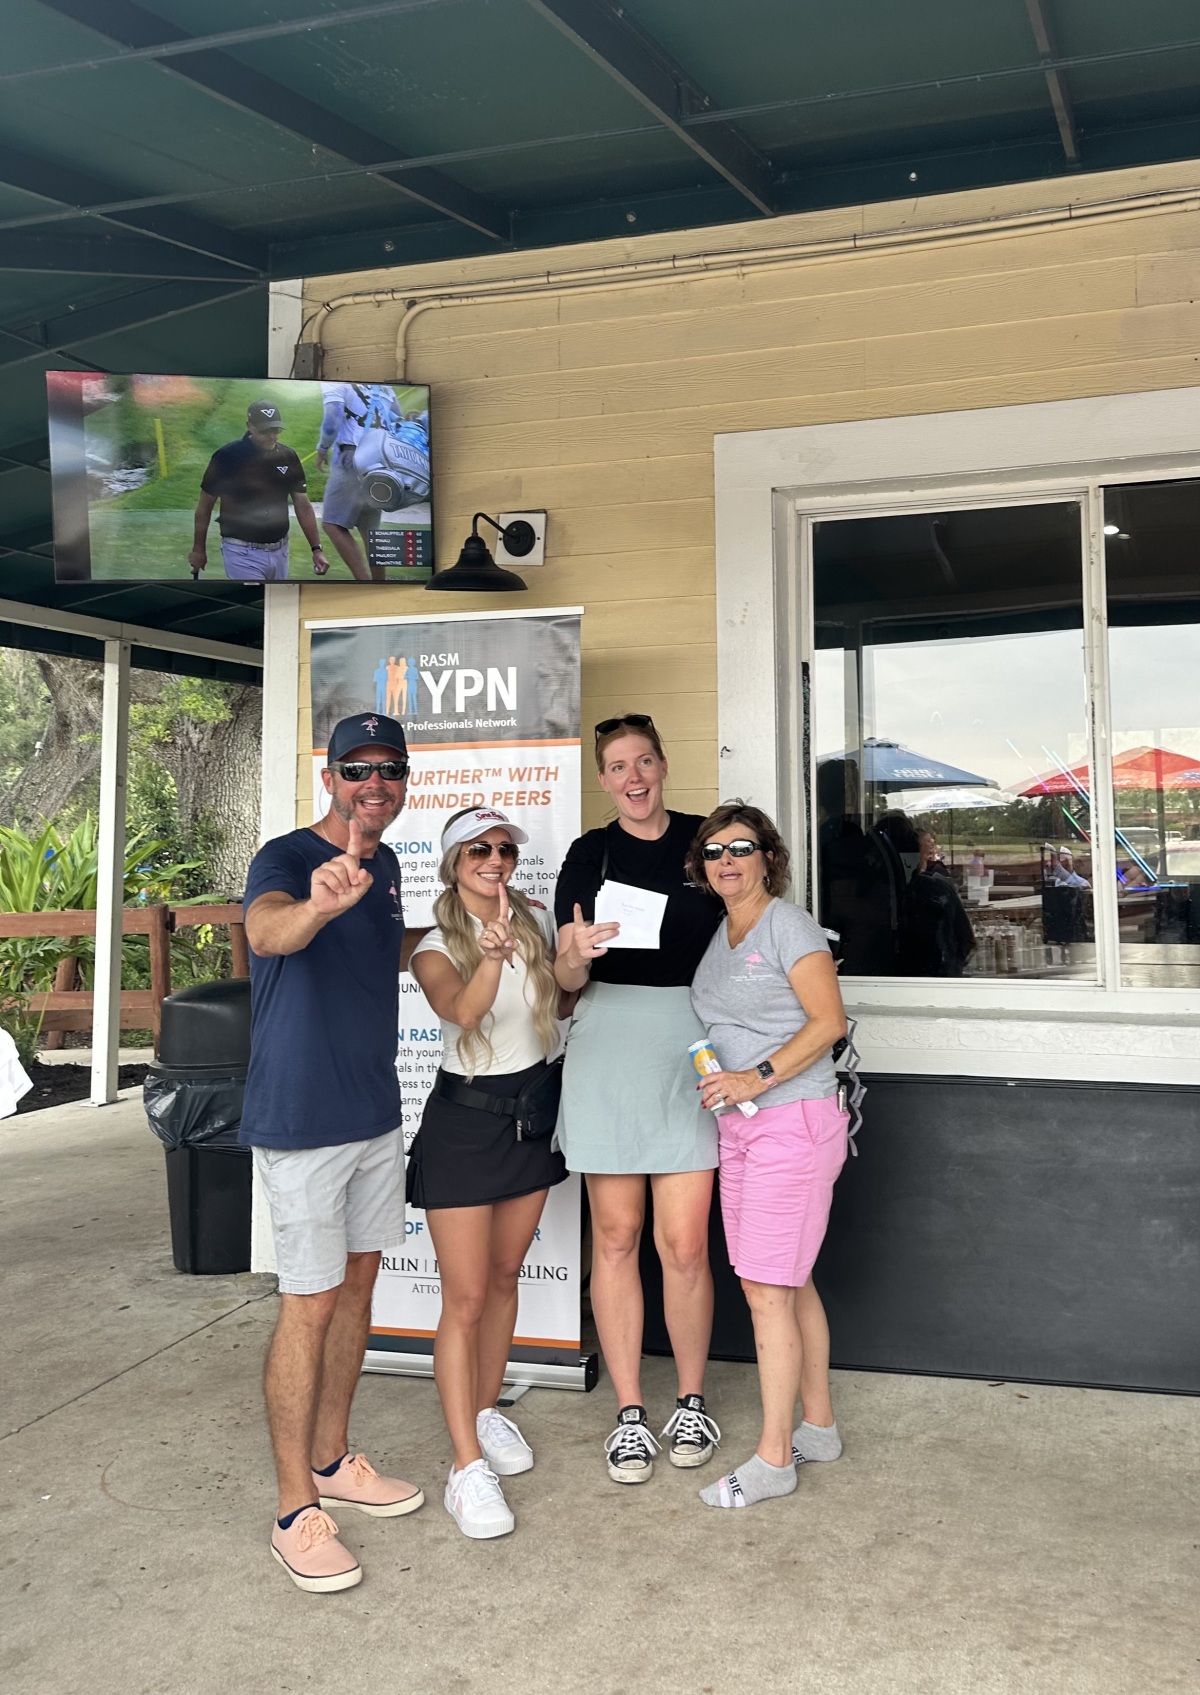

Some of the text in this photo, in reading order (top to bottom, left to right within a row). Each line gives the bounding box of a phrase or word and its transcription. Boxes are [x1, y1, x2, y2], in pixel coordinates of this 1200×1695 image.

[420, 653, 459, 668] RASM
[420, 666, 517, 714] YPN
[407, 719, 473, 731] Professionals
[475, 717, 517, 728] Network
[508, 766, 559, 783] WITH
[491, 790, 552, 807] PEERS
[420, 858, 438, 868] real
[515, 870, 533, 880] the
[539, 885, 549, 894] in
[398, 1045, 413, 1057] ith
[396, 1062, 411, 1072] als
[415, 1062, 424, 1072] in
[421, 1079, 432, 1088] to
[405, 1221, 423, 1235] OF
